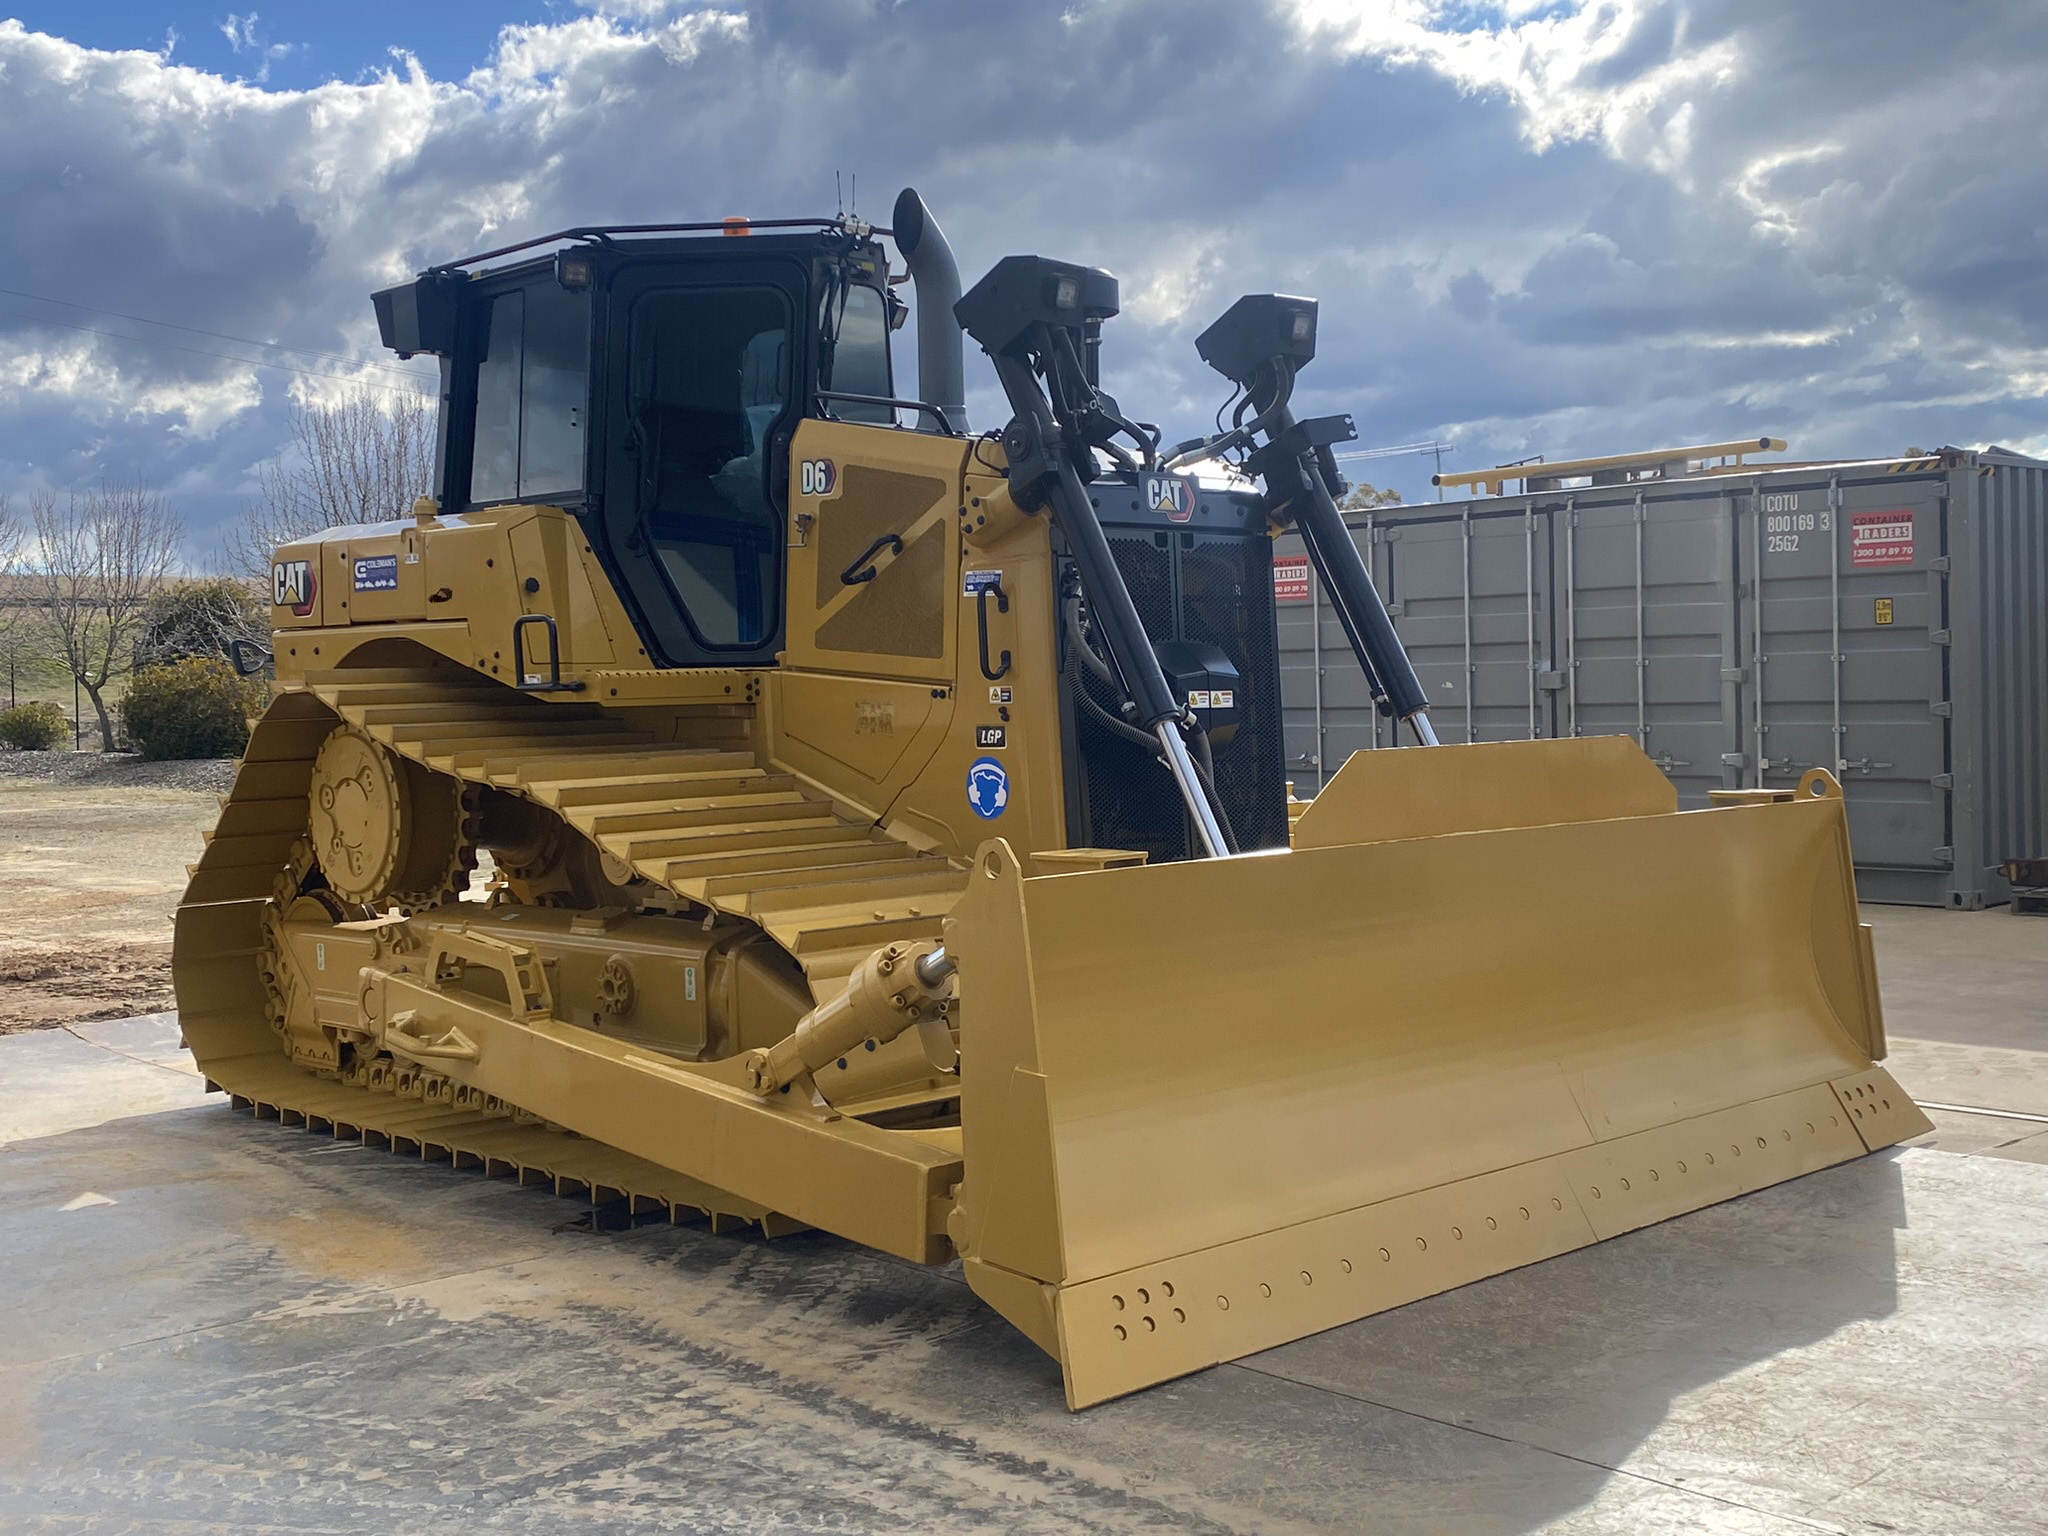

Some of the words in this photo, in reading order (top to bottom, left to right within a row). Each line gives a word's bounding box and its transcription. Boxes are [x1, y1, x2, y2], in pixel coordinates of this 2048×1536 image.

[802, 460, 827, 493] D6
[1147, 478, 1182, 511] CAT
[1767, 494, 1798, 512] COTU
[1767, 513, 1815, 533] 800169
[1821, 513, 1830, 530] 3
[1853, 515, 1912, 525] CONTAINER
[1858, 526, 1909, 539] TRADERS
[1768, 534, 1799, 553] 25G2
[1853, 548, 1874, 557] 1300
[1875, 548, 1887, 556] 89
[1888, 547, 1900, 555] 89
[1901, 546, 1913, 554] 70
[1276, 569, 1305, 579] RADERS
[273, 562, 306, 605] CAT
[980, 730, 1002, 744] LGP
